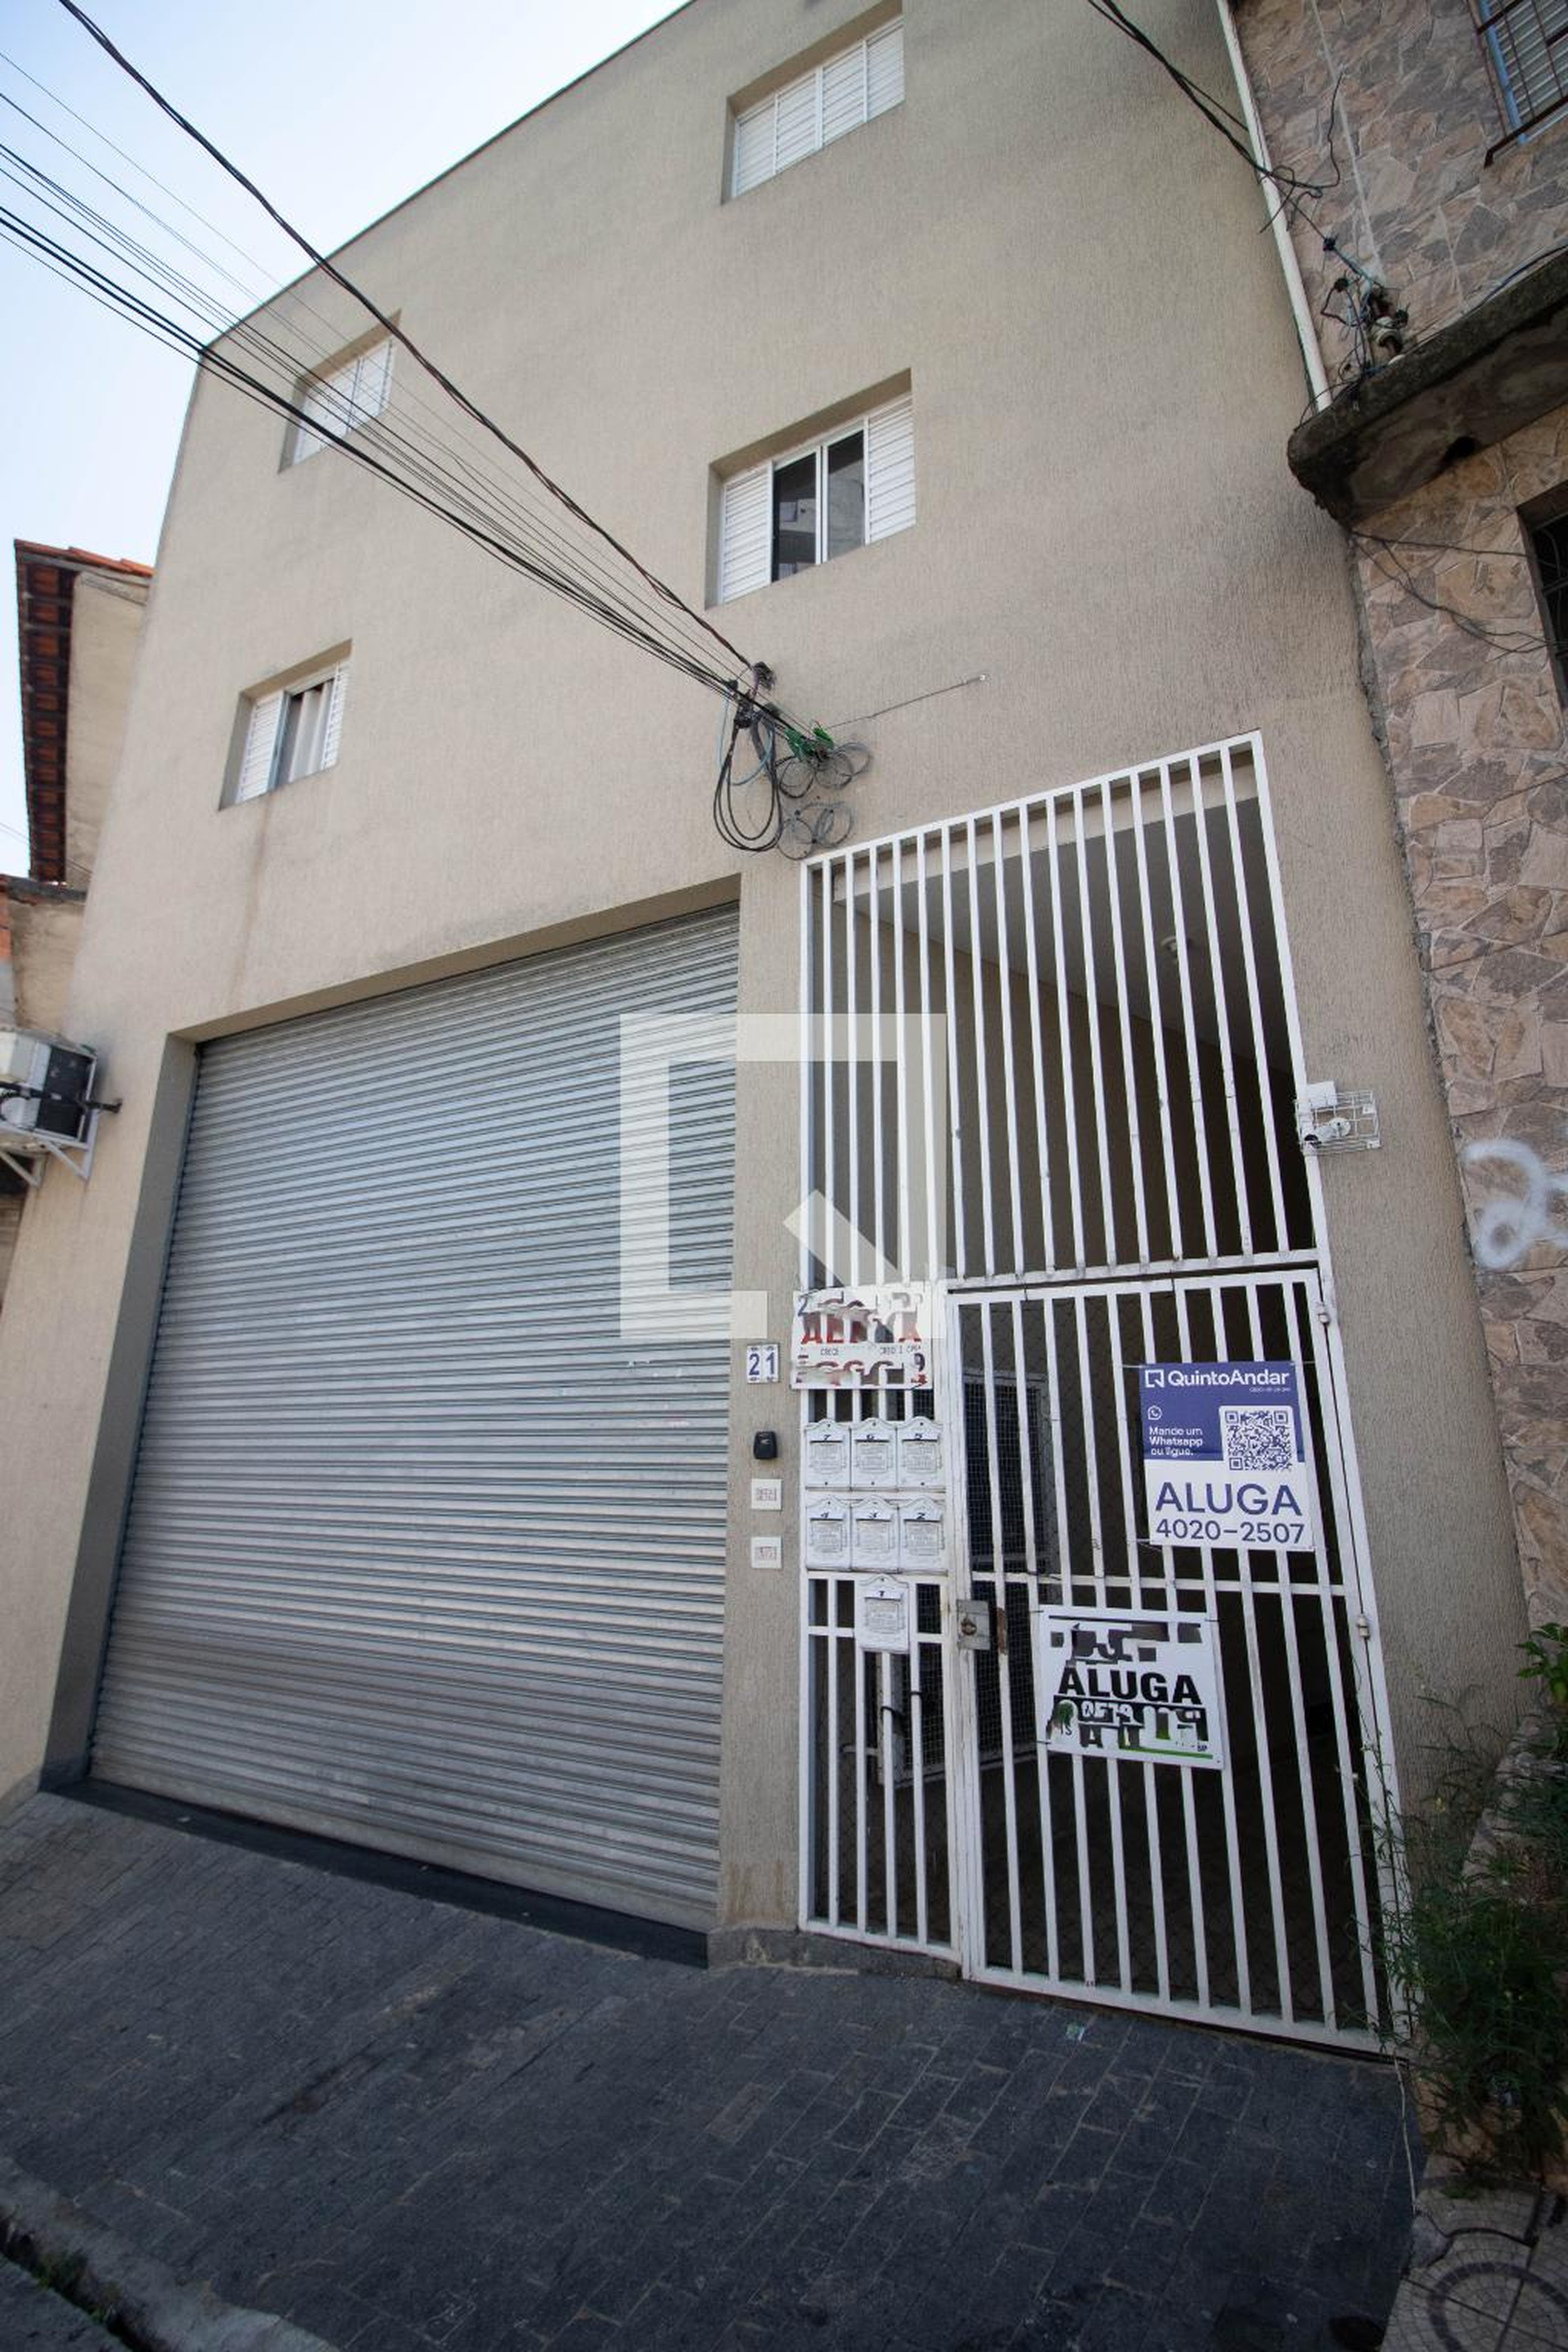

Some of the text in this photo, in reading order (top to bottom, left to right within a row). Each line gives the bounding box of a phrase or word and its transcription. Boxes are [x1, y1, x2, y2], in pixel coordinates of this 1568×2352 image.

[749, 1352, 774, 1375] 21
[1168, 1369, 1290, 1387] QuintoAndar
[1149, 1426, 1203, 1436] Mande um
[1149, 1437, 1203, 1447] Whatsapp
[1156, 1482, 1303, 1516] ALUGA
[1156, 1519, 1305, 1544] 4020-2507
[1058, 1666, 1203, 1705] ALUGA
